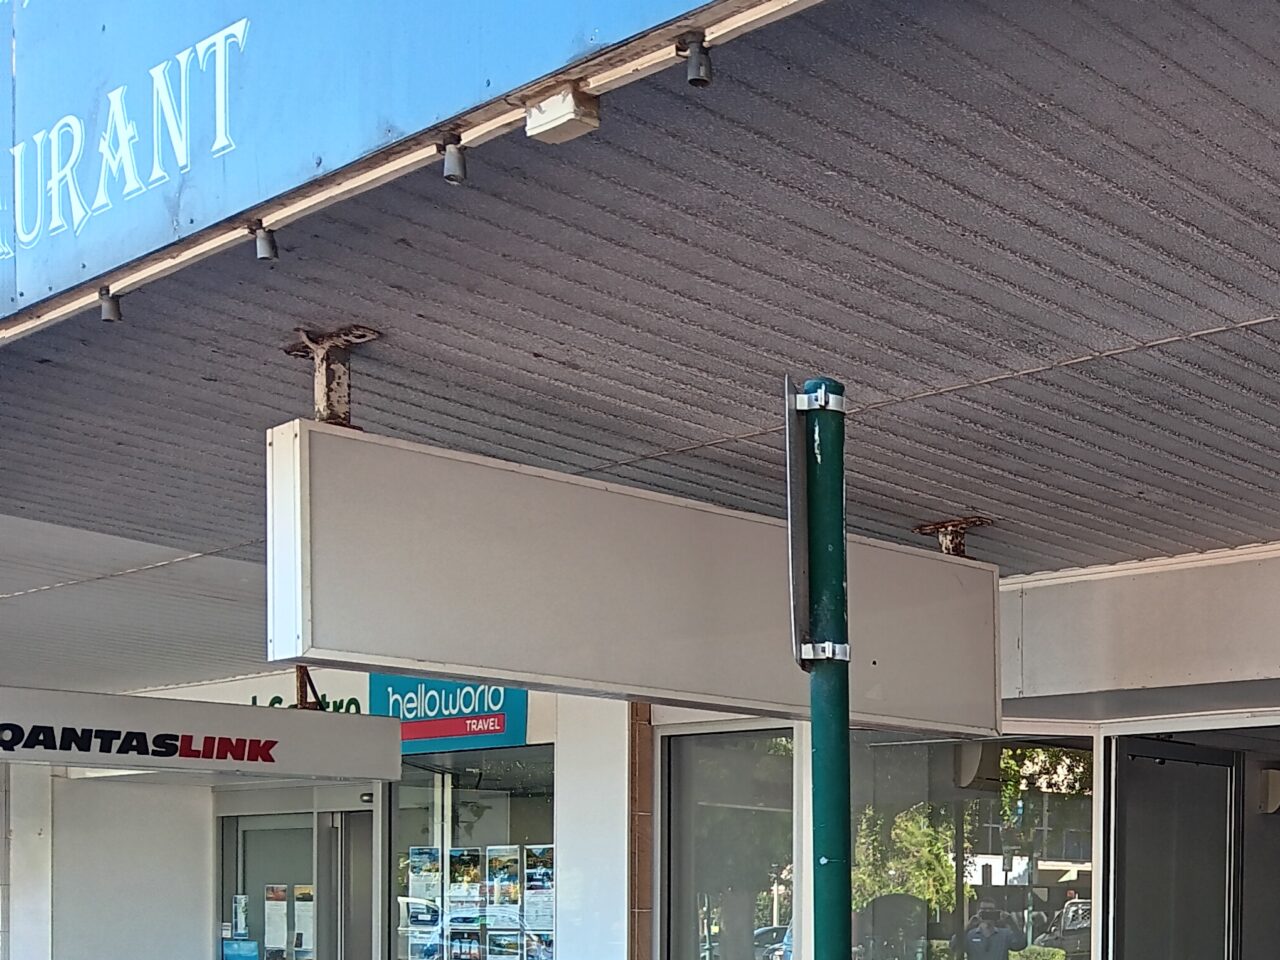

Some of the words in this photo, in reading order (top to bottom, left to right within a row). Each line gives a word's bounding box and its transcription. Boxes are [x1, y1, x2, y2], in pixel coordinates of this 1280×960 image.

[387, 683, 505, 720] helloworld
[0, 722, 279, 763] QANTASLINK
[465, 717, 501, 732] TRAVEL
